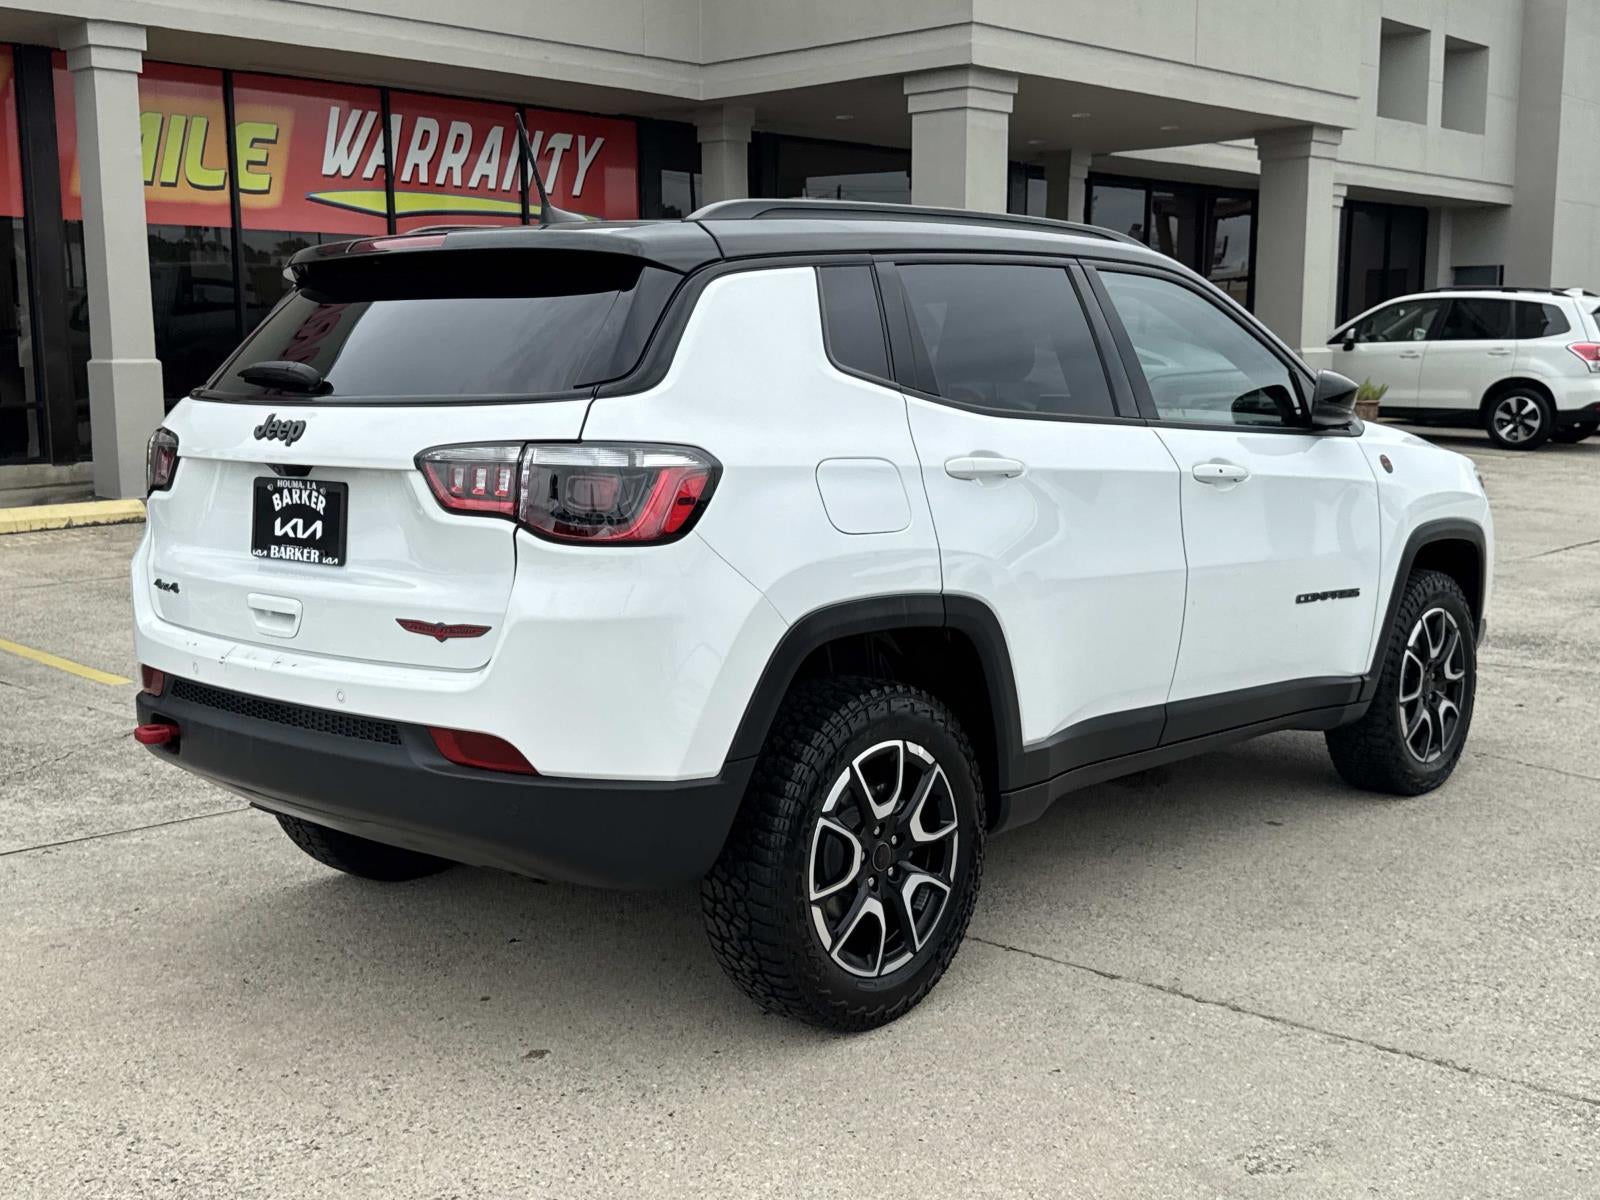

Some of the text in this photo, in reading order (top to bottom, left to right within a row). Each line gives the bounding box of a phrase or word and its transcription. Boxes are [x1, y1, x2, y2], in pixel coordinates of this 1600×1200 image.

[321, 106, 605, 197] WARRANTY
[253, 413, 307, 447] Jeep
[307, 481, 317, 490] LA
[272, 488, 326, 516] BARKER
[274, 516, 323, 540] KIA
[270, 545, 319, 563] BARKER
